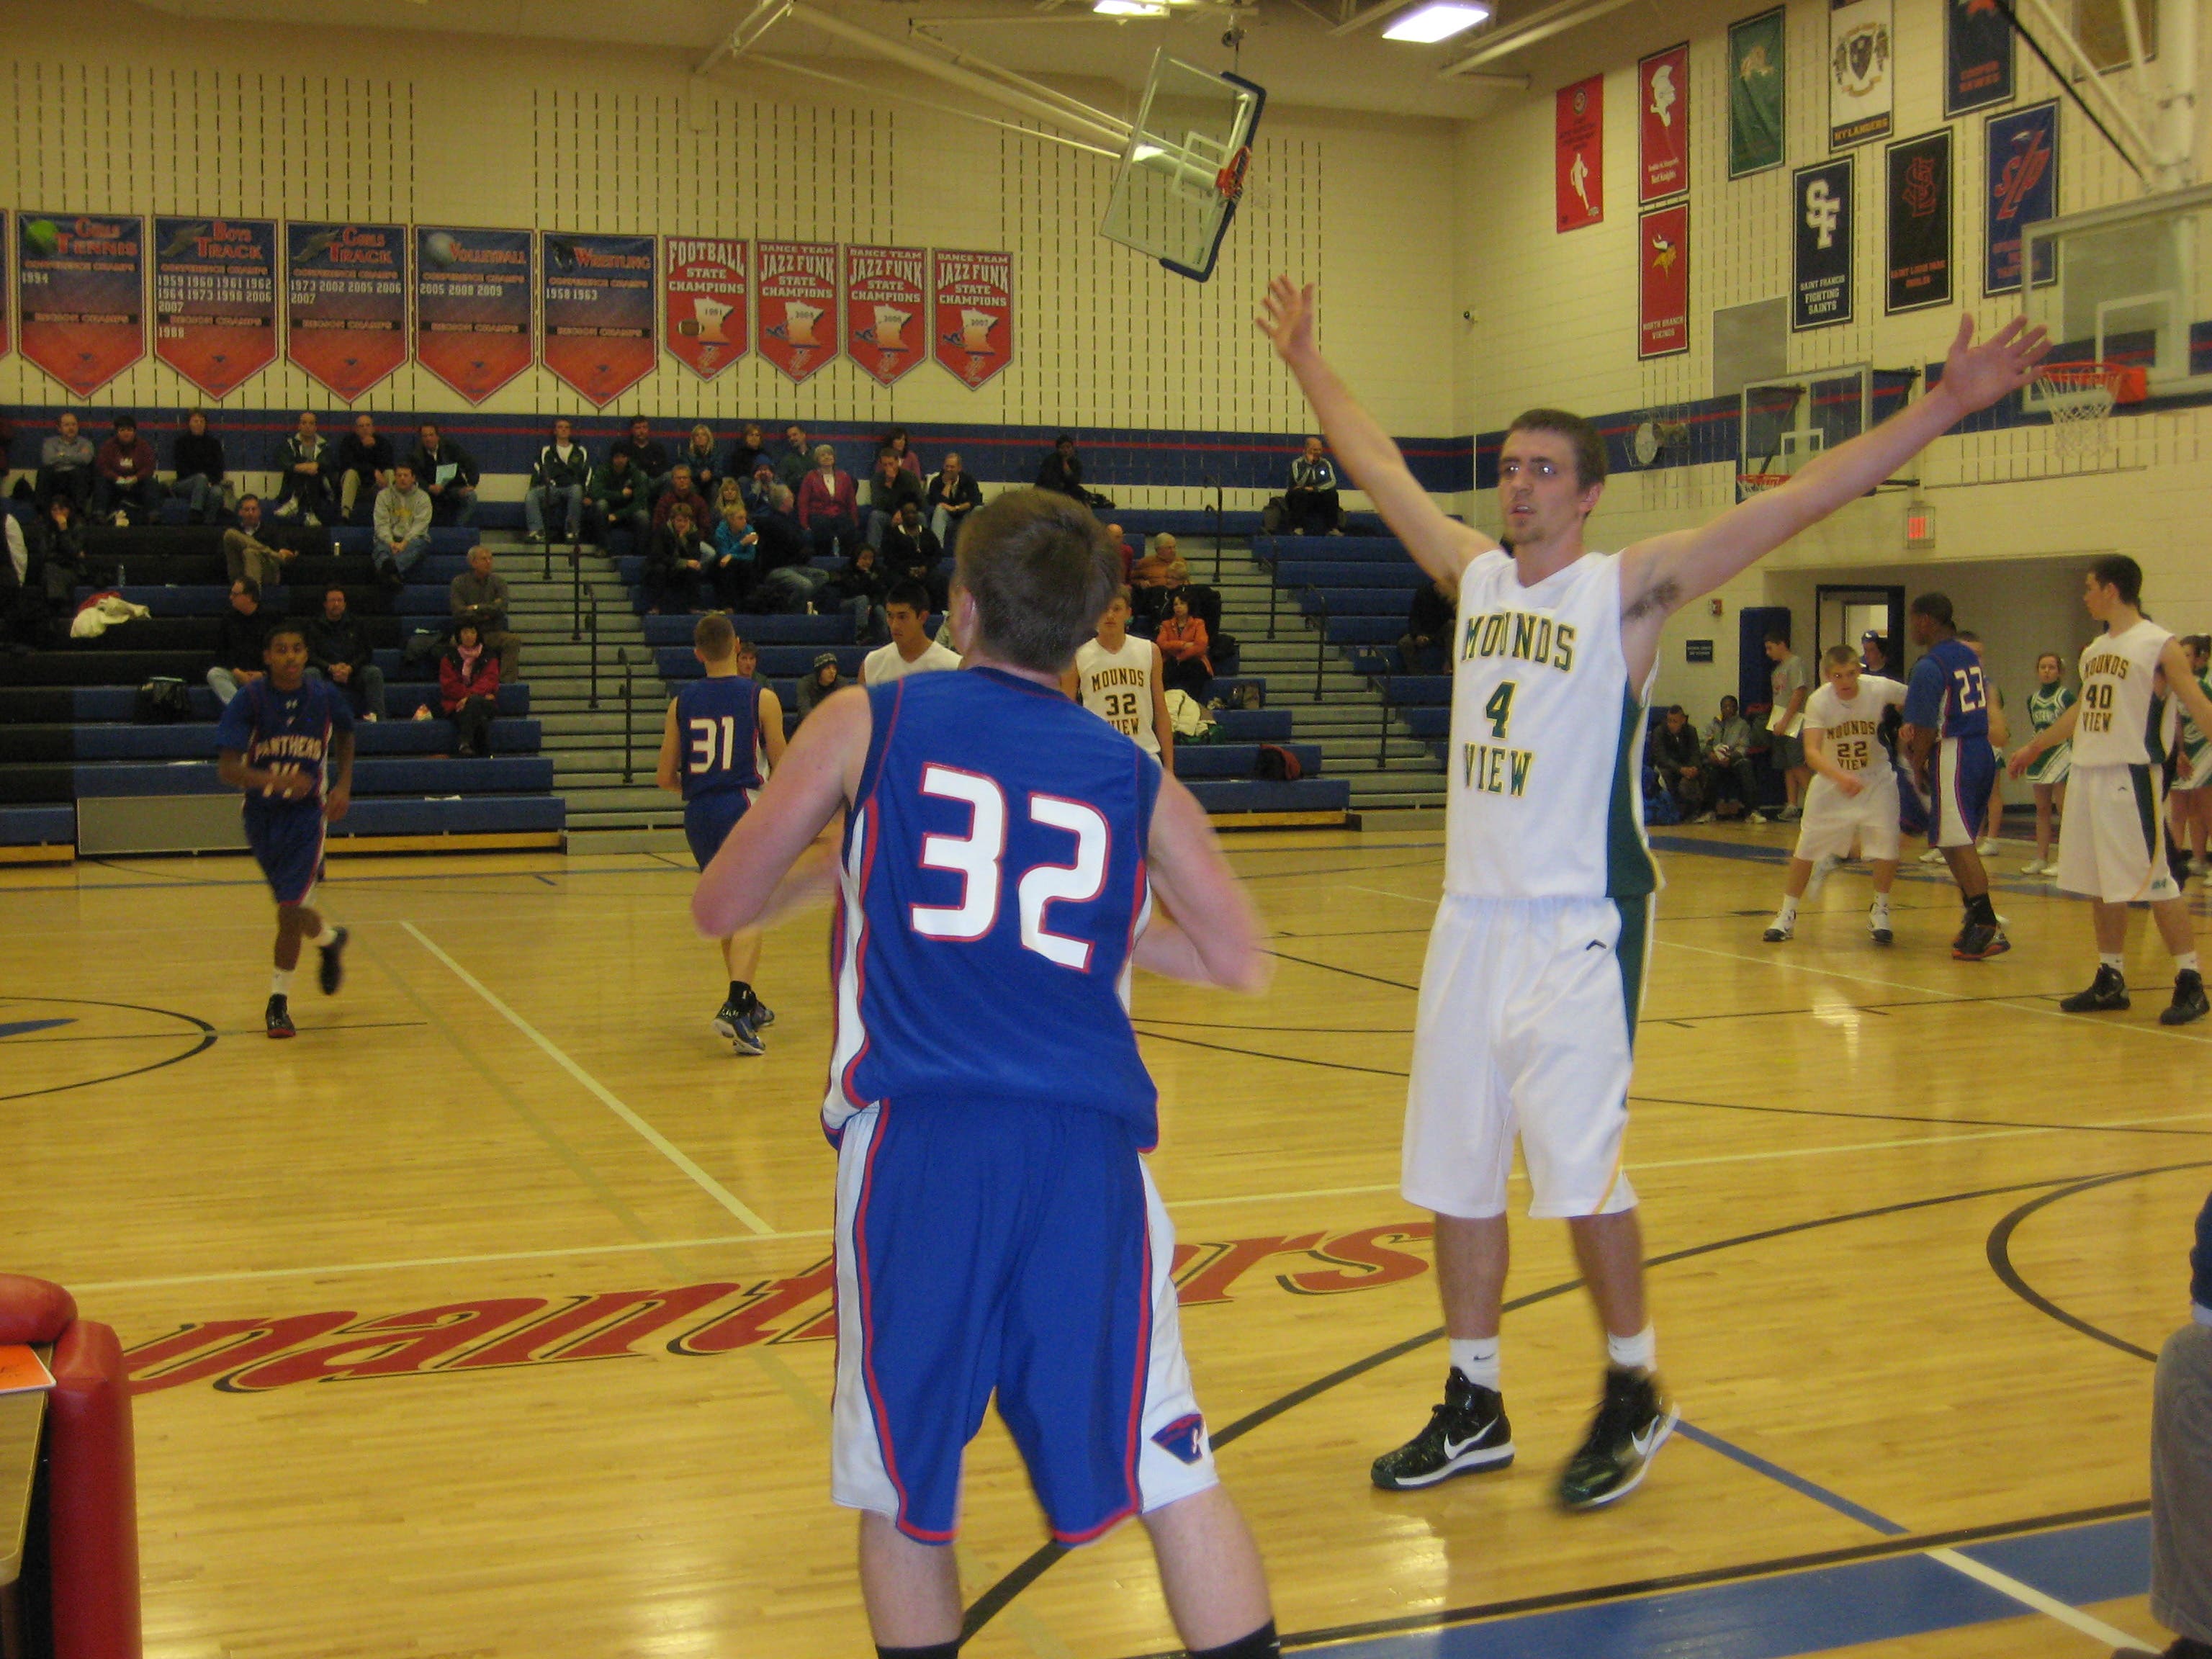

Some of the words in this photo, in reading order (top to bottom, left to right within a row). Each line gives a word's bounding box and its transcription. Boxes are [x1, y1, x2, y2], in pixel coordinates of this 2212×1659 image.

[54, 232, 138, 256] TENNIS
[193, 237, 263, 259] TRACK
[325, 241, 392, 264] TRACK
[573, 247, 651, 269] WRESTLING
[669, 240, 745, 276] FOOTBALL
[938, 253, 974, 261] DANCE
[686, 268, 727, 279] STATE
[760, 254, 794, 282] JAZZ
[796, 255, 835, 287] FUNK
[850, 258, 883, 286] JAZZ
[886, 259, 922, 290] FUNK
[938, 262, 970, 289] JAZZ
[972, 264, 1008, 294] FUNK
[291, 279, 316, 291] 1973
[320, 281, 345, 292] 2002
[669, 281, 745, 294] CHAMPIONS
[779, 275, 816, 287] STATE
[867, 279, 904, 290] STATE
[955, 284, 992, 294] STATE
[1800, 279, 1820, 291] SAINT
[292, 293, 316, 304] 2007
[762, 287, 833, 299] CHAMPIONS
[851, 290, 921, 302] CHAMPIONS
[939, 295, 1007, 306] CHAMPIONS
[1804, 288, 1839, 304] FIGHTING
[158, 301, 184, 313] 2007
[1809, 300, 1837, 315] SAINTS
[2084, 654, 2128, 680] MOUNDS
[1092, 668, 1143, 692] MOUNDS
[1953, 666, 1987, 713] 23
[1105, 693, 1137, 716] 32
[2085, 684, 2113, 709] 40
[1485, 679, 1519, 739] 4
[1827, 720, 1875, 739] MOUNDS
[2082, 711, 2112, 732] VIEW
[690, 716, 734, 773] 31
[1837, 741, 1867, 757] 22
[1465, 742, 1534, 797] VIEW
[1838, 757, 1867, 770] VIEW
[909, 762, 1112, 973] 32
